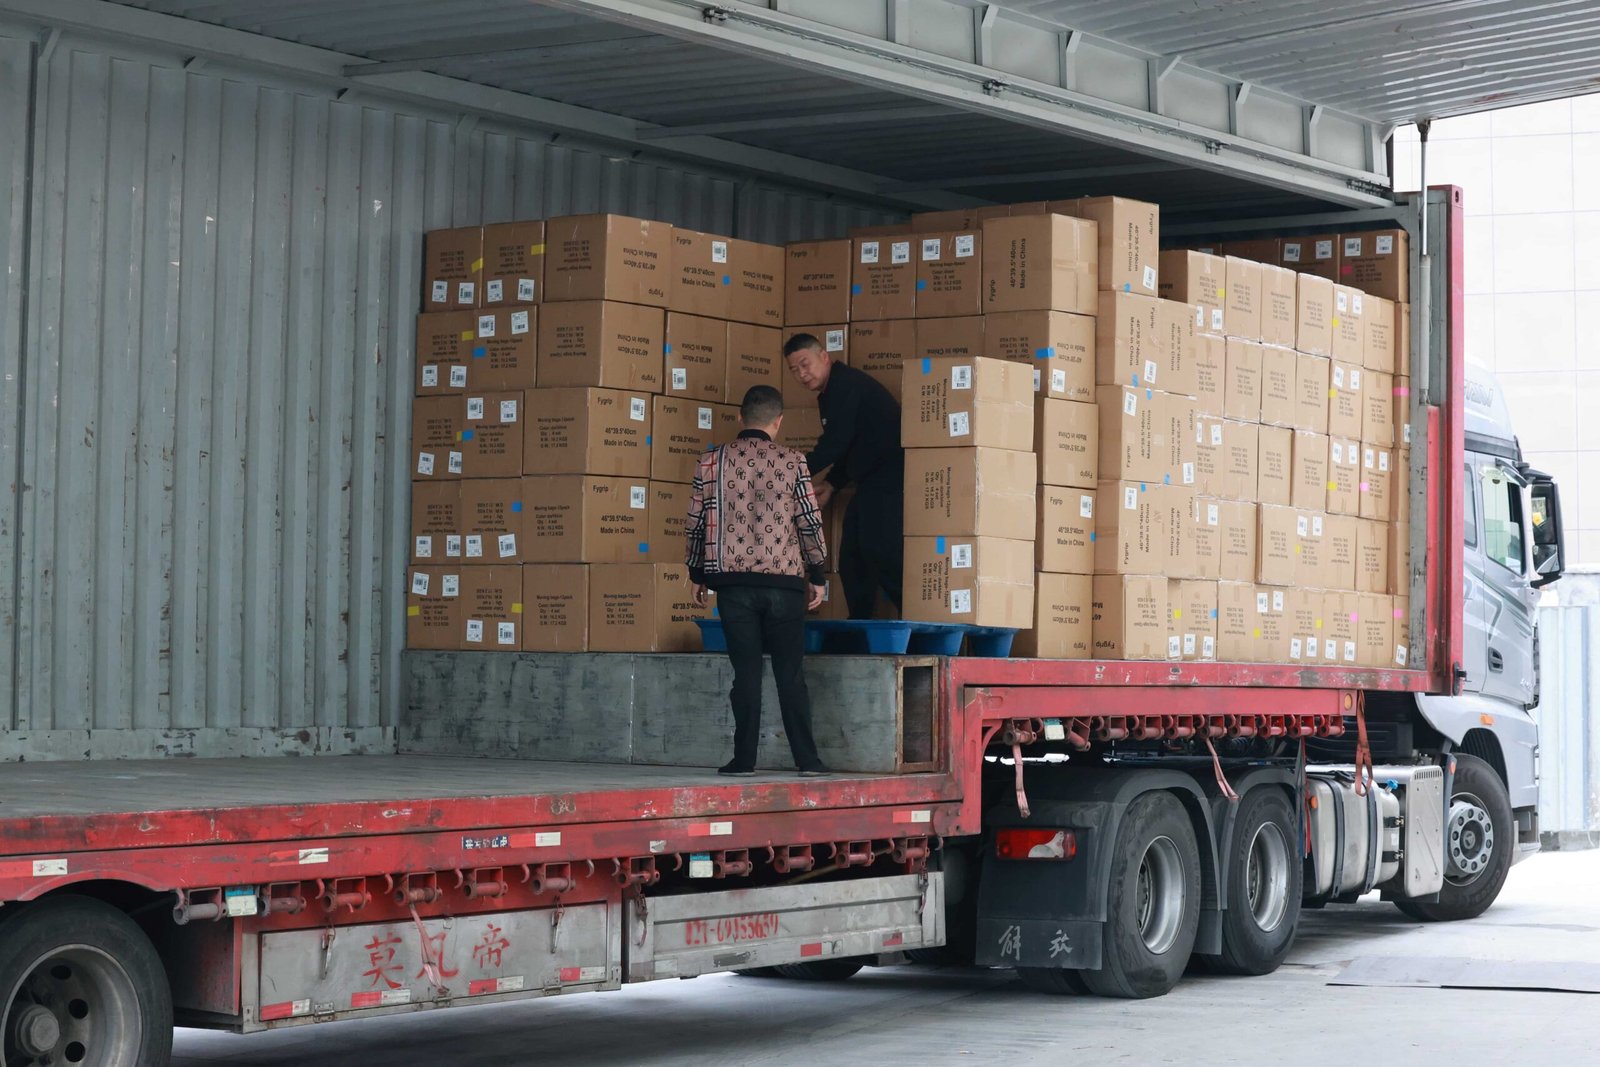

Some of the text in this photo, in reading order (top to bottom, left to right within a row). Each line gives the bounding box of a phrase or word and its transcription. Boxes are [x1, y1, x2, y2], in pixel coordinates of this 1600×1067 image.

[1464, 379, 1494, 408] AW
[728, 481, 793, 491] G N G N
[729, 502, 788, 511] N G N G
[728, 524, 789, 534] G N G N
[728, 546, 786, 555] N G N G
